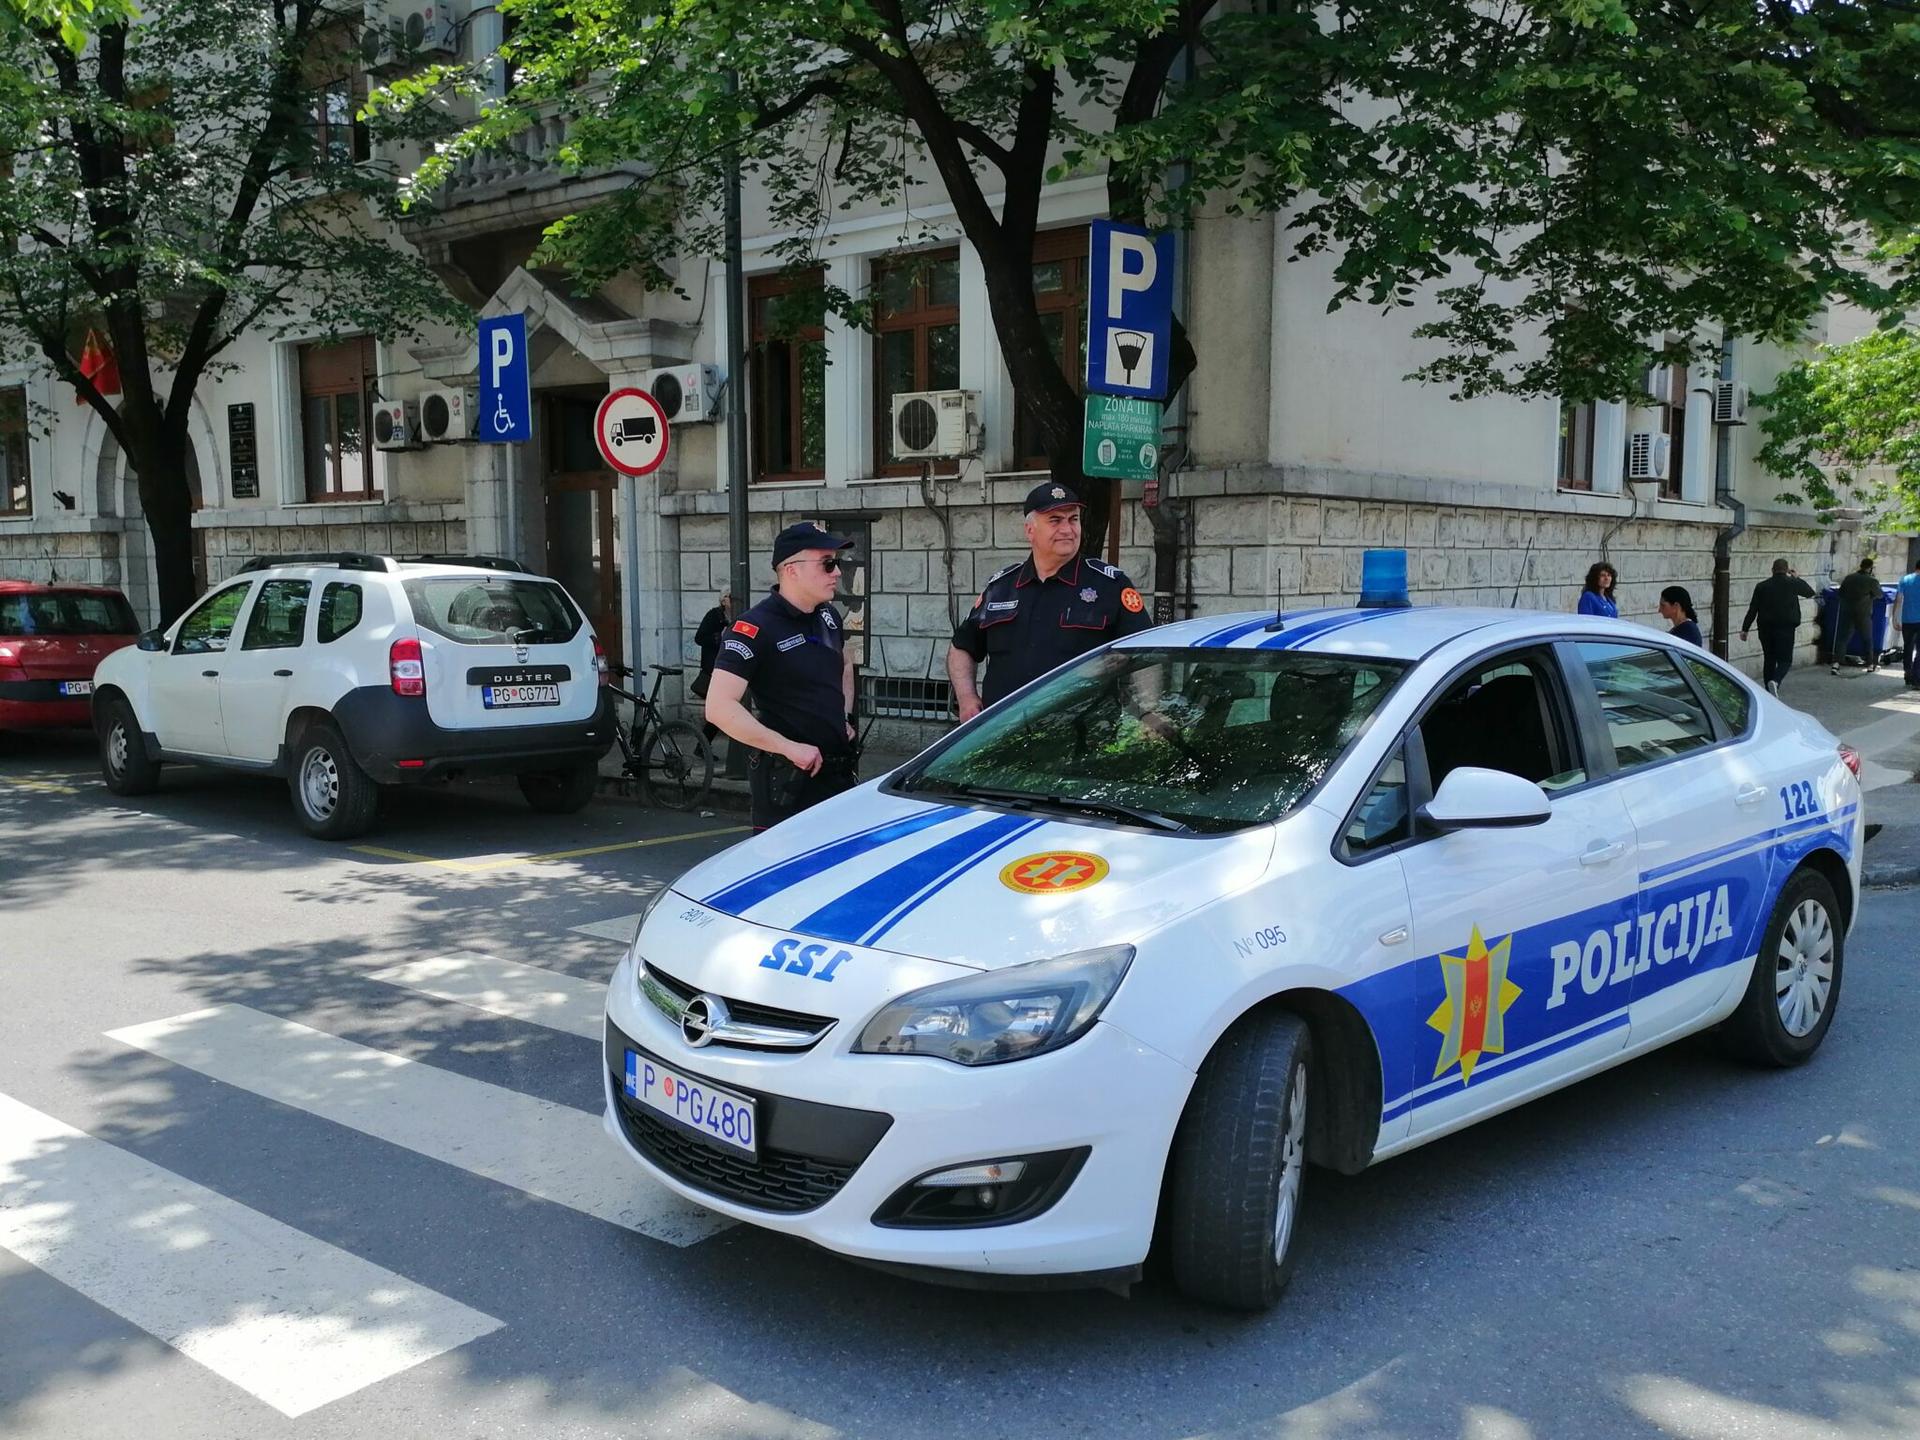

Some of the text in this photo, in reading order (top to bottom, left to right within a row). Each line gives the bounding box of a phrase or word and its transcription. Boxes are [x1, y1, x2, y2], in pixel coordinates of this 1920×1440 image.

[1107, 230, 1158, 319] P
[491, 327, 514, 388] P
[1104, 397, 1150, 415] ZONA III
[1088, 420, 1121, 431] NAPLATA
[726, 641, 751, 657] POLICIJA
[67, 682, 82, 693] PG
[493, 673, 553, 683] DUSTER
[493, 688, 511, 702] PG
[518, 686, 557, 701] CG771
[1780, 780, 1819, 820] 122
[1255, 925, 1287, 949] 095
[1546, 884, 1733, 1010] POLICIJA
[644, 1063, 752, 1145] P PG480
